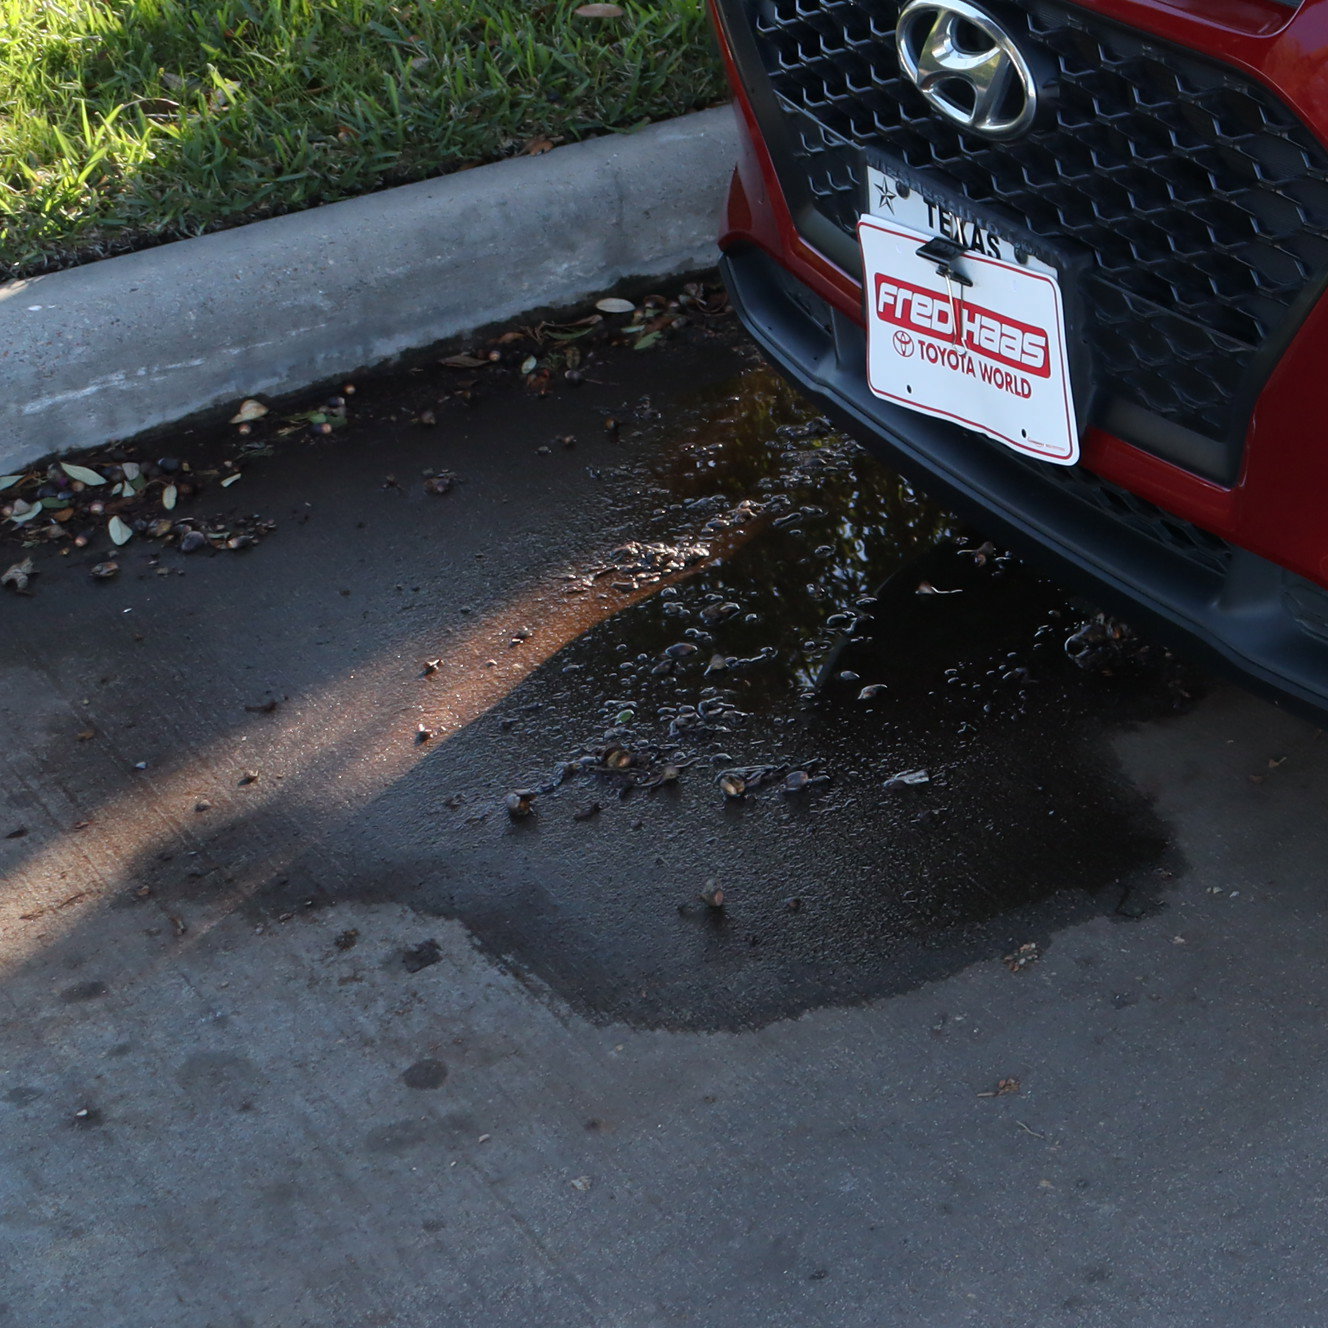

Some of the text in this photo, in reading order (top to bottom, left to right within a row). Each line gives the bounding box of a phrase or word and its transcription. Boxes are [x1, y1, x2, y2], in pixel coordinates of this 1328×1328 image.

[923, 196, 1002, 261] TEXAS
[918, 339, 1032, 400] TOYOTA WORLD
